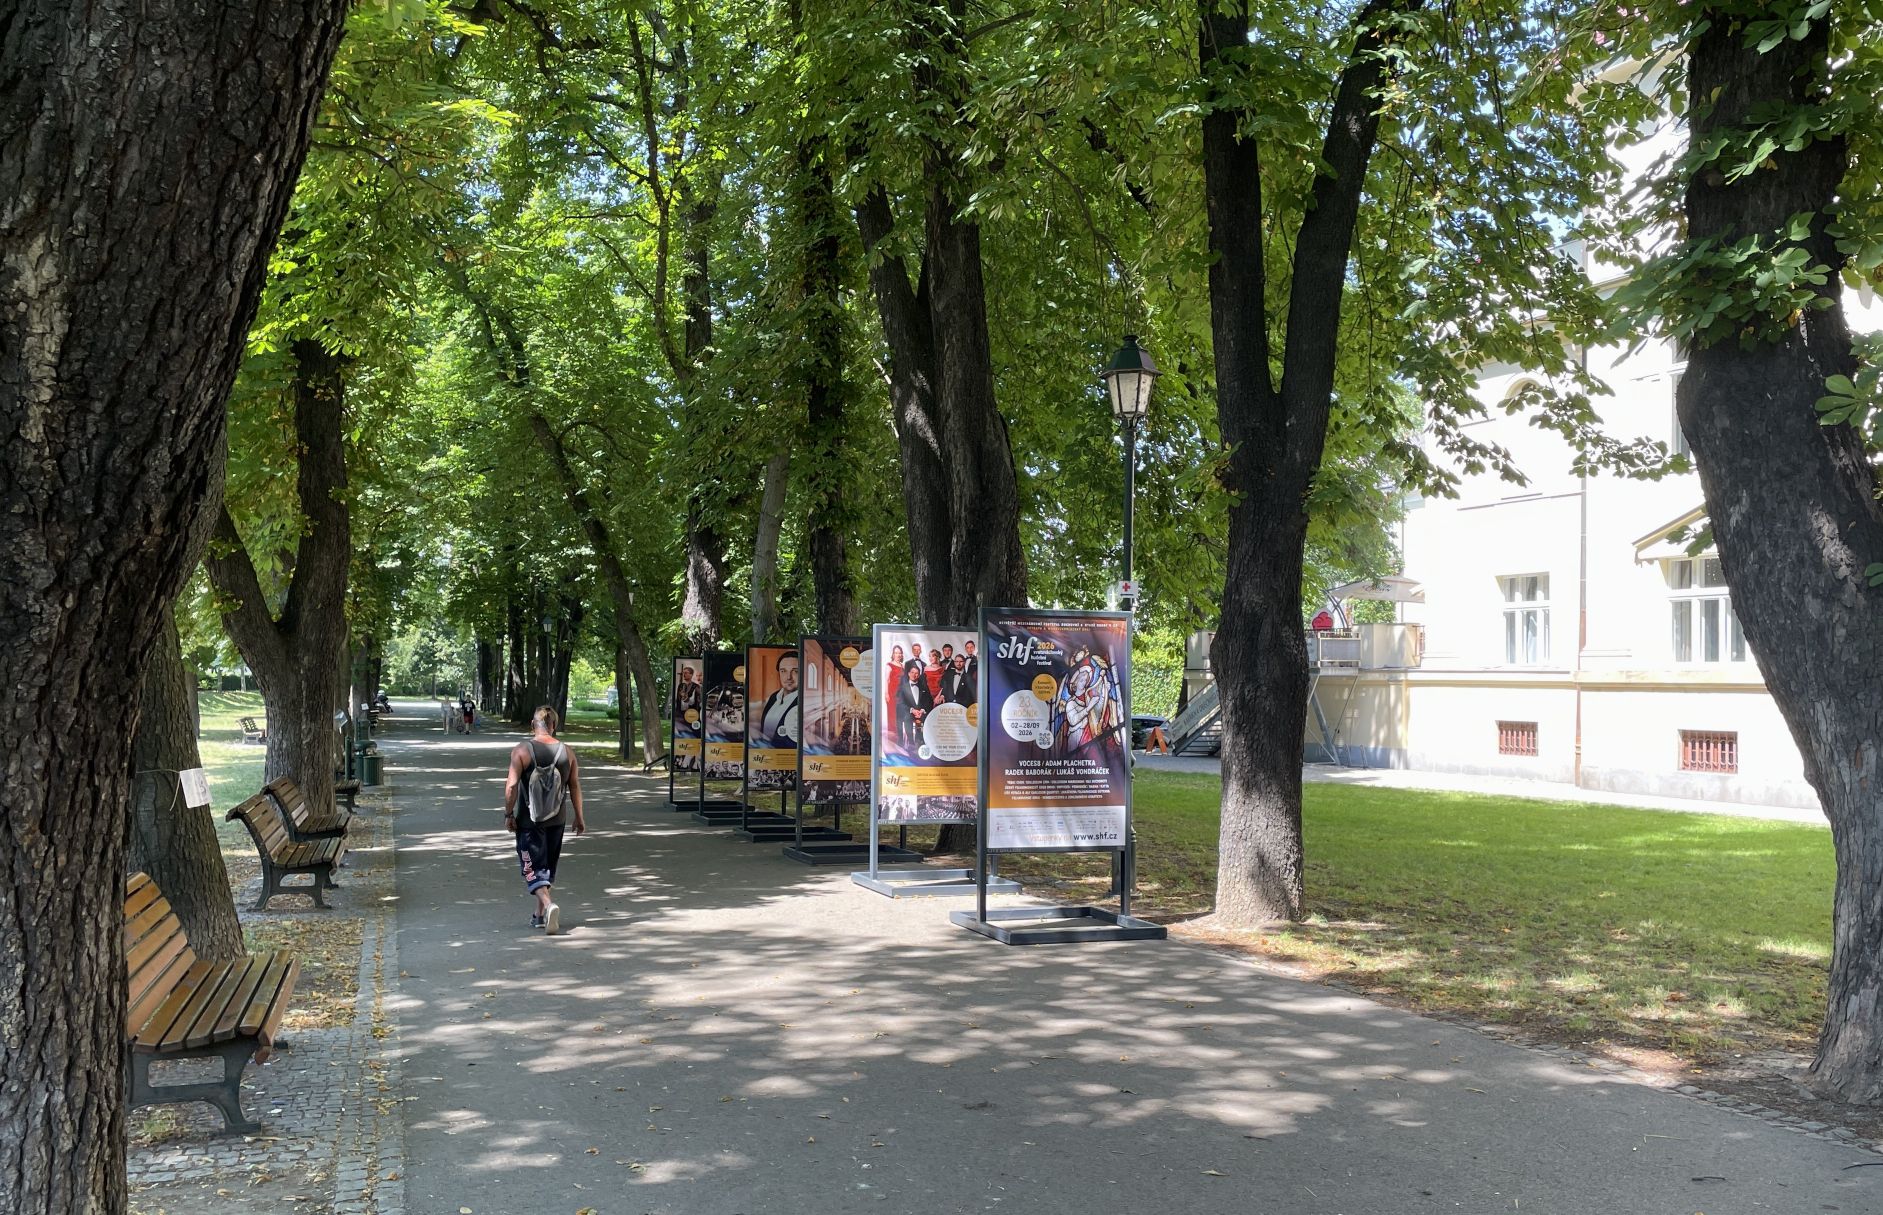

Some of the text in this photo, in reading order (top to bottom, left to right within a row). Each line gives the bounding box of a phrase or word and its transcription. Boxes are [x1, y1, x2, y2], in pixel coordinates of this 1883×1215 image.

[1037, 641, 1055, 650] 2026
[997, 636, 1038, 665] shf
[809, 762, 824, 773] shf
[1063, 759, 1096, 767] PLACHETKA
[1056, 767, 1074, 775] LUKÁŠ
[885, 775, 902, 786] shf
[1073, 831, 1118, 840] www.shf.cz
